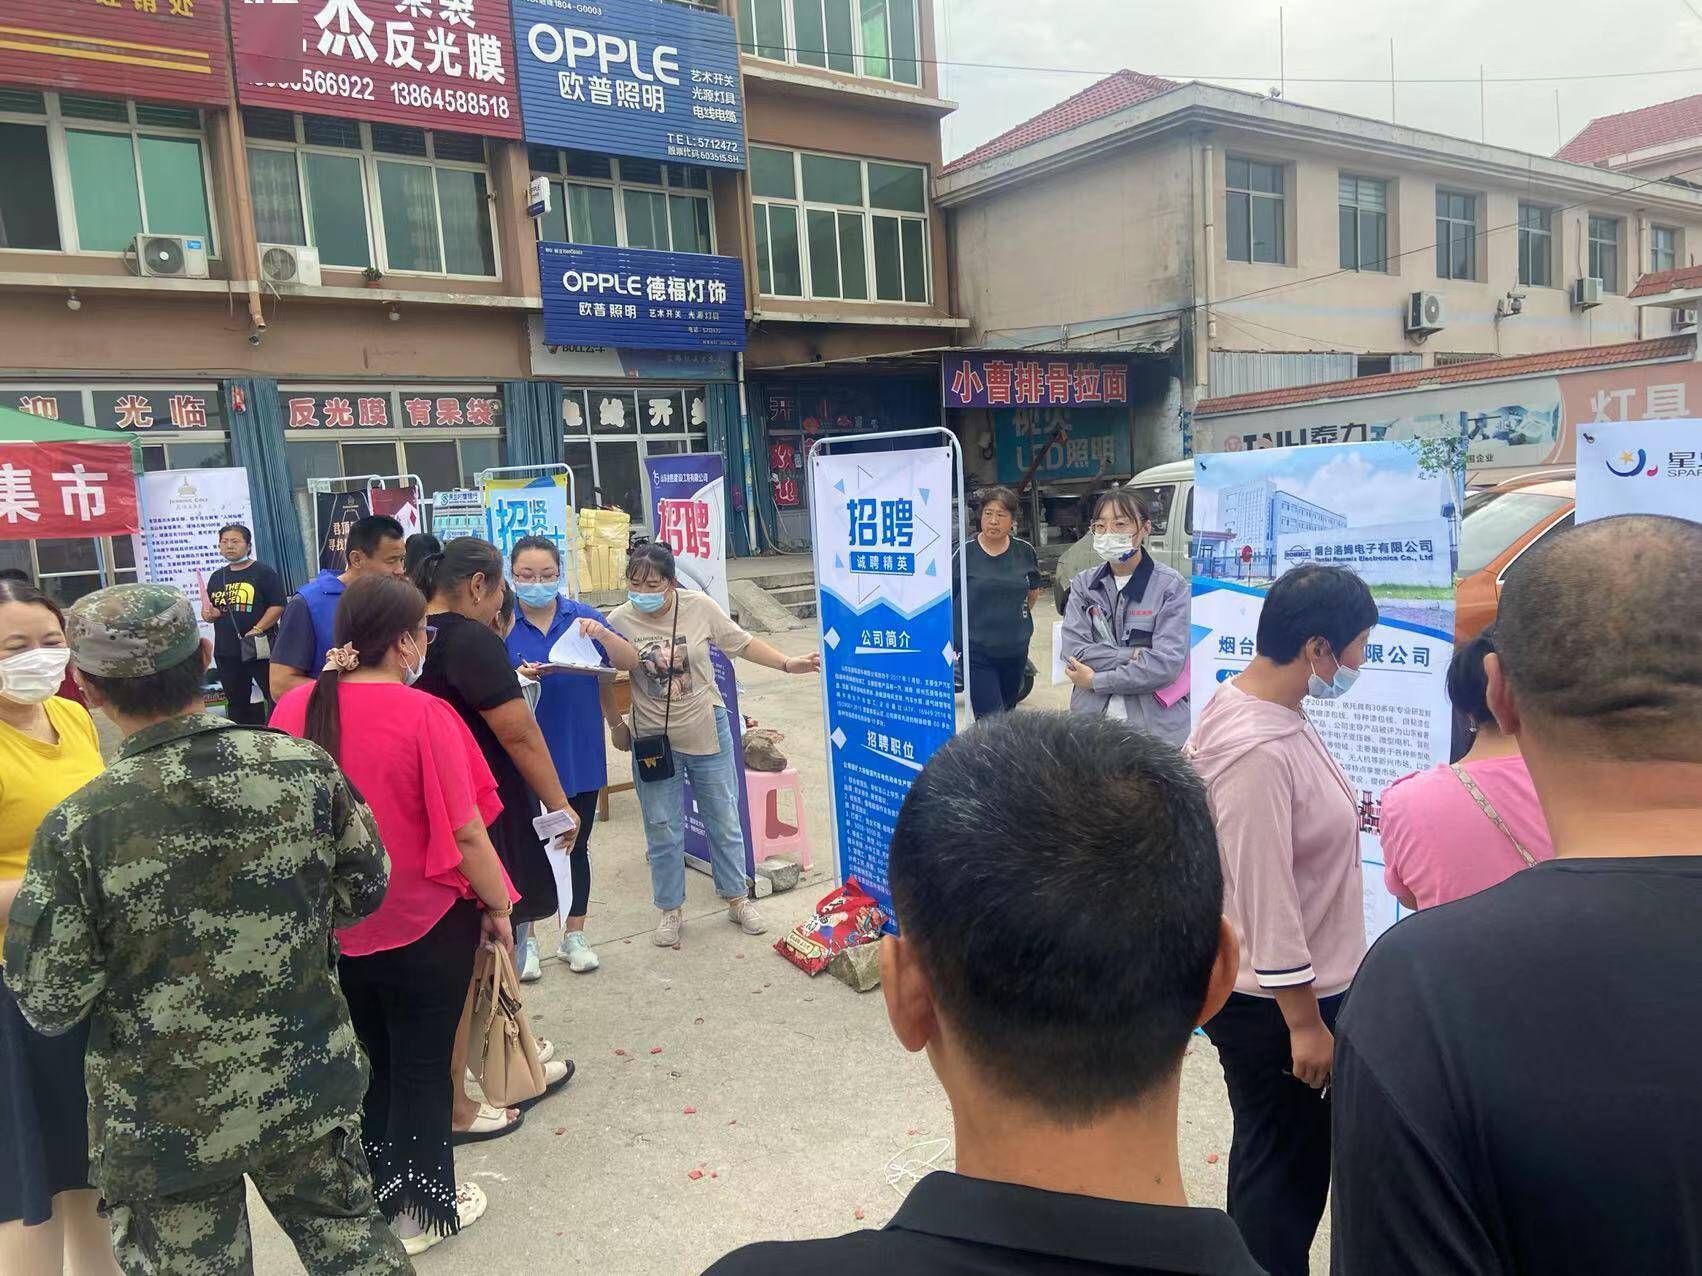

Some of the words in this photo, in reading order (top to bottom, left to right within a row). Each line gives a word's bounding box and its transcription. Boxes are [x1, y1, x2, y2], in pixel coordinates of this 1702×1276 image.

[384, 21, 506, 85] 反光膜
[528, 23, 680, 86] OPPLE
[558, 71, 665, 114] 欧普照明
[690, 68, 735, 88] 艺术开关
[390, 82, 511, 119] 13864588518
[692, 87, 736, 105] 光源灯具
[693, 104, 738, 123] 电线电缆
[562, 270, 642, 296] OPPLE
[646, 275, 727, 305] 德福灯饰
[579, 301, 638, 319] 欧普照明
[951, 360, 1128, 404] 小曹排骨拉面
[288, 397, 389, 428] 反光膜
[404, 397, 495, 427] 育果袋
[1590, 383, 1690, 422] 灯具
[1668, 451, 1702, 468] 星
[0, 463, 109, 523] 集市
[658, 500, 710, 558] 招聘
[847, 498, 914, 546] 招聘
[856, 555, 908, 572] 诚聘精英
[1314, 540, 1433, 556] 烟台洛姆电子有限公司
[861, 630, 911, 648] 公司简介
[867, 729, 914, 759] 招聘职位
